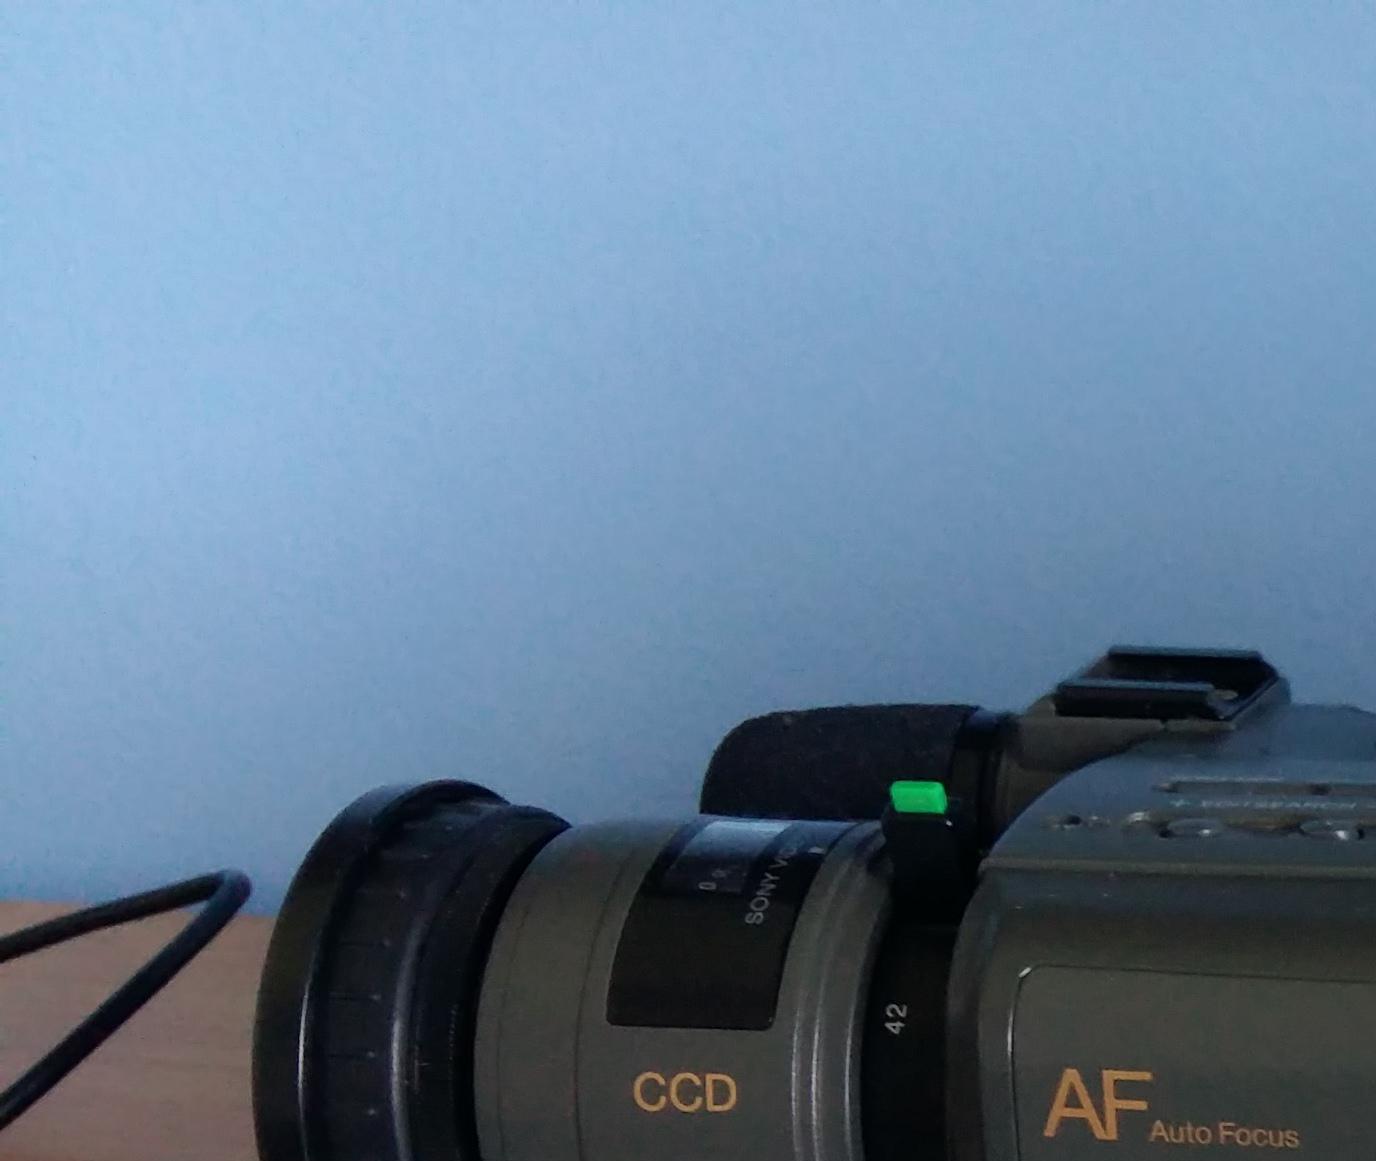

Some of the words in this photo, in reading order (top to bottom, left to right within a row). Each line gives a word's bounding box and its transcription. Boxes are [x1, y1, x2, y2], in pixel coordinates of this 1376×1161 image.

[745, 872, 781, 925] SONY
[884, 1003, 907, 1034] 42
[632, 1071, 738, 1112] CCD
[1043, 1068, 1153, 1141] AF
[1150, 1120, 1212, 1145] Auto
[1219, 1121, 1300, 1149] Focus
